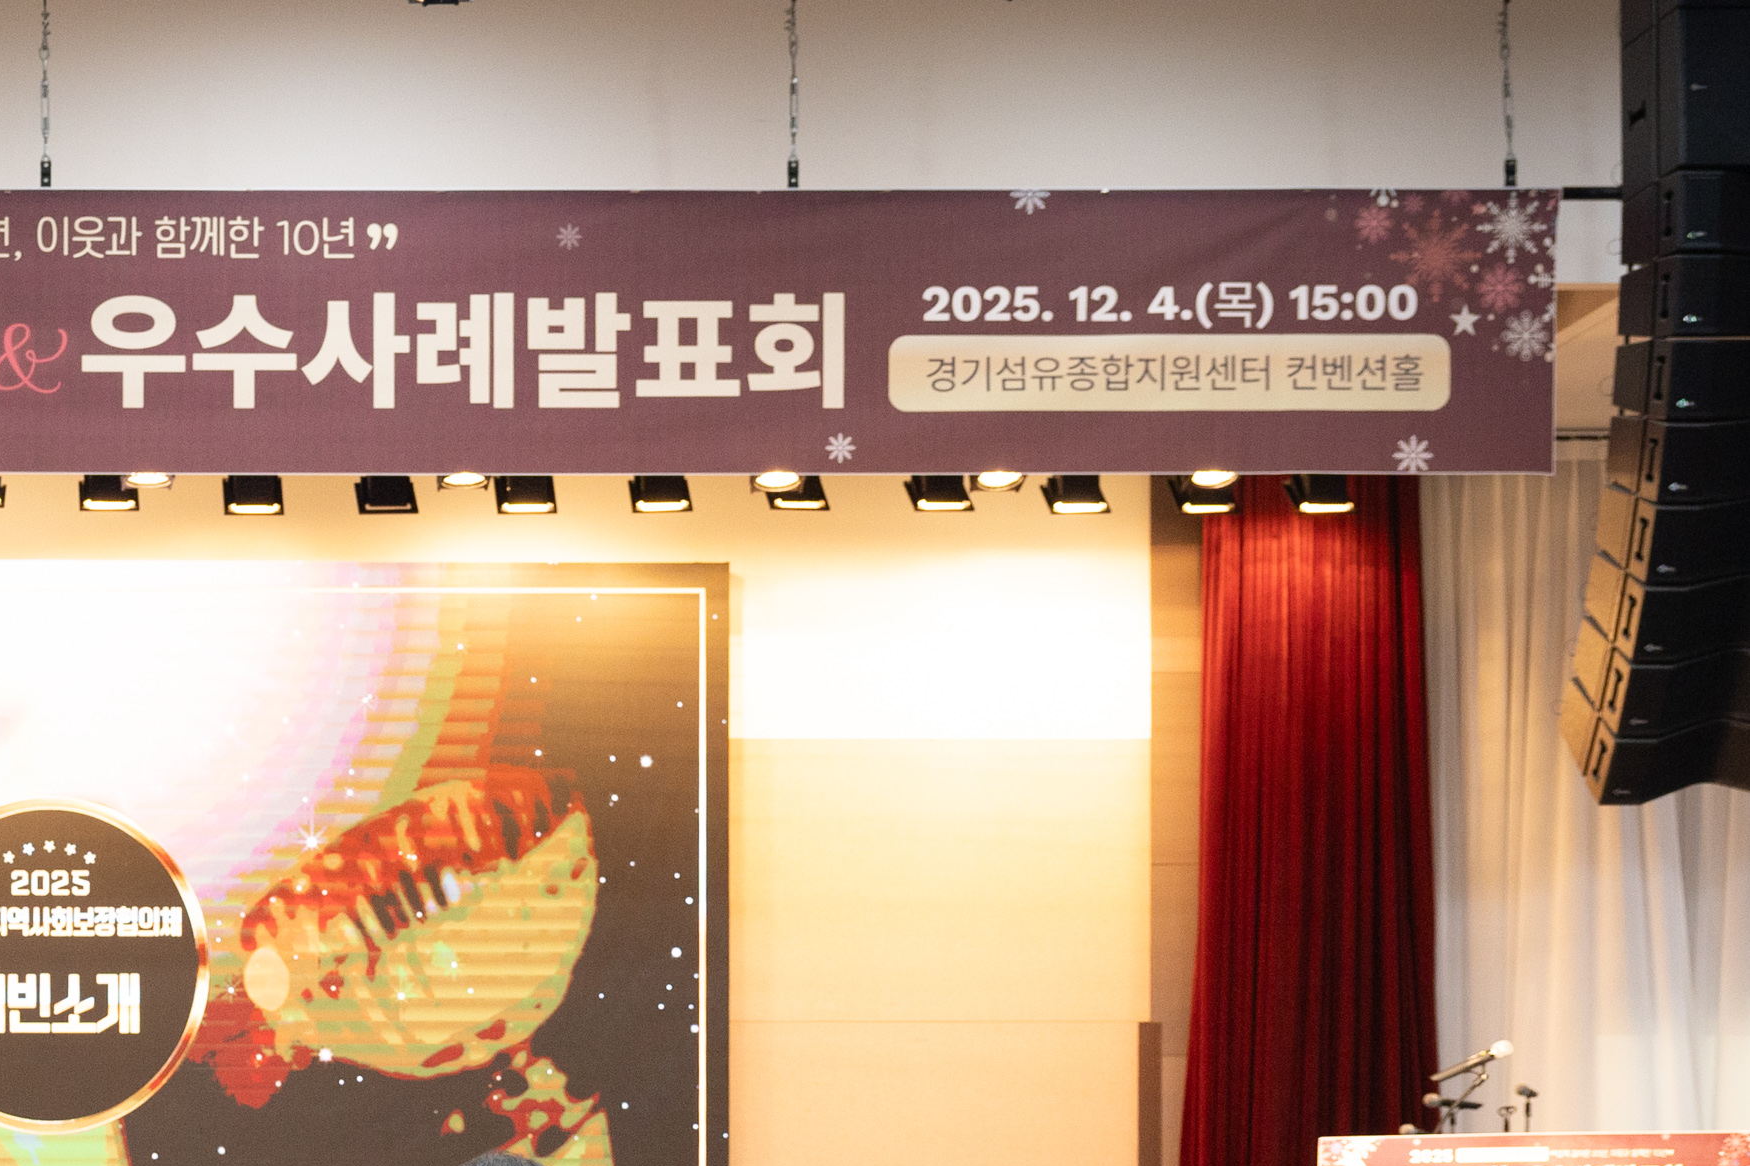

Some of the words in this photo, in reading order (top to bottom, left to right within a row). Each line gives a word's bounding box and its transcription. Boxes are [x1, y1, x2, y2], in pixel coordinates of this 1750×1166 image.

[37, 216, 143, 260] 이웃과
[154, 215, 265, 260] 함께한
[922, 286, 1055, 323] 2025.
[1068, 285, 1134, 323] 12.
[1147, 282, 1275, 330] 4.(목)
[1289, 285, 1418, 322] 15:00
[81, 292, 846, 410] 우수사례발표회
[926, 354, 1272, 394] 경기섬유종합지원센터
[1286, 353, 1426, 393] 컨벤션홀
[10, 869, 92, 898] 2025
